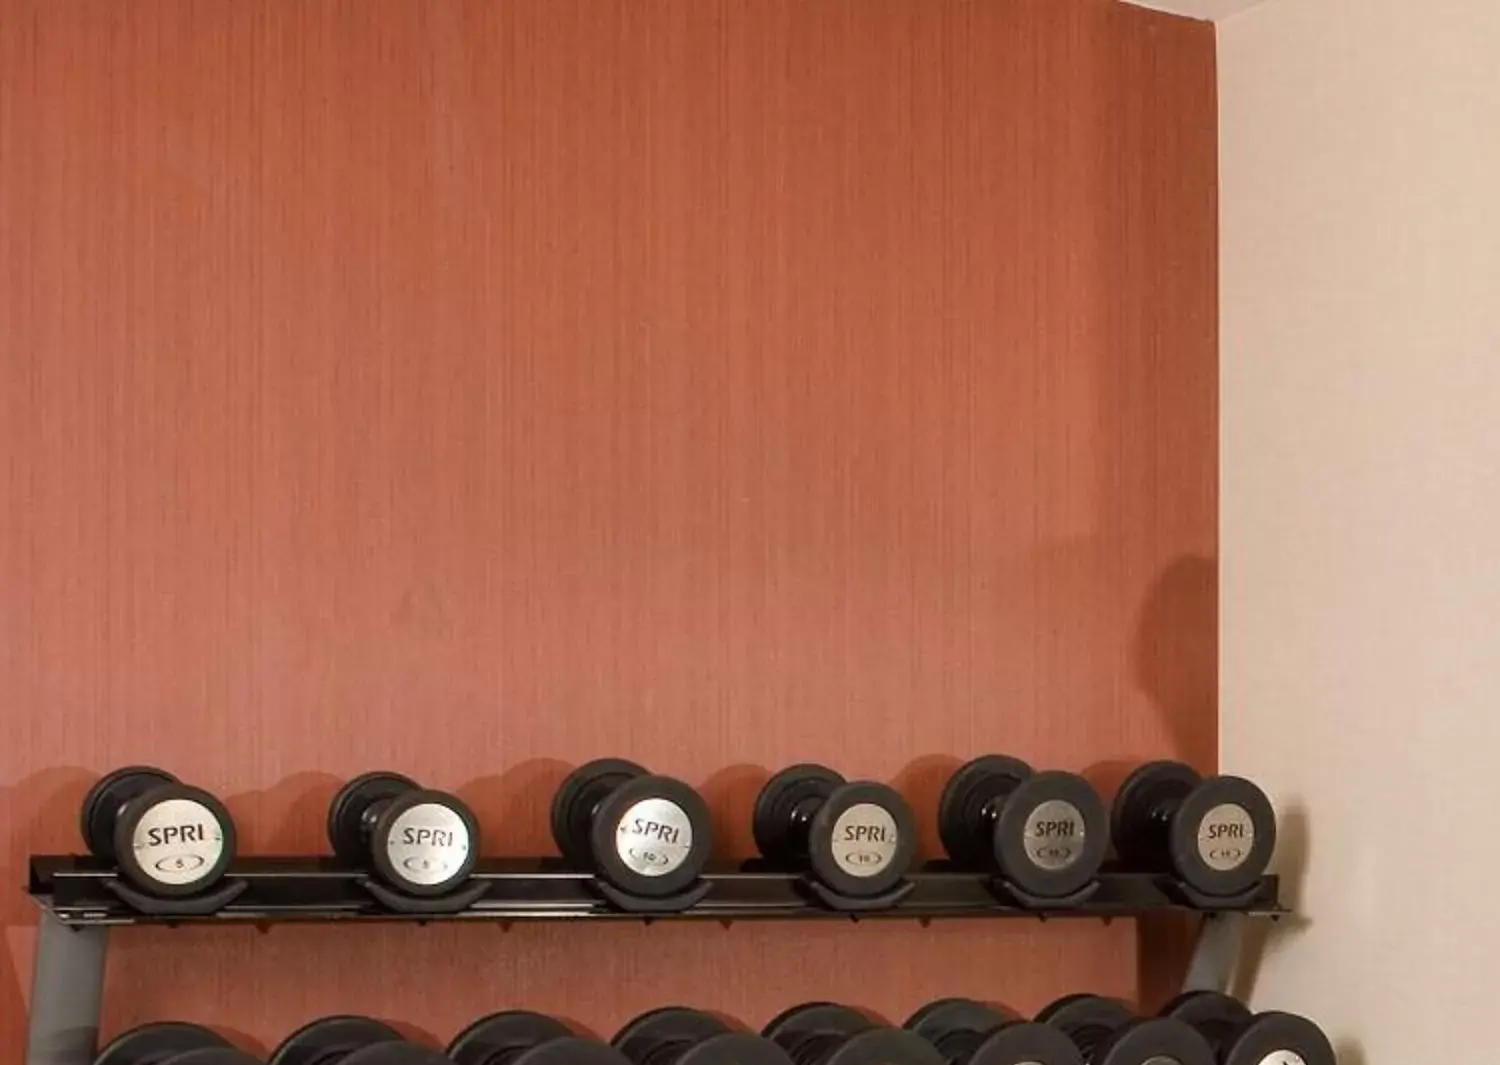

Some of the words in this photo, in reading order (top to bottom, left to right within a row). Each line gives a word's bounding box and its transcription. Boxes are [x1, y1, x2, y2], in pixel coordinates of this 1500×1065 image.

[147, 823, 204, 847] SPRI
[403, 827, 454, 848] SPRI
[632, 818, 679, 844] SPRI
[843, 825, 886, 843] SPRI
[1034, 820, 1075, 837] SPRI
[1207, 822, 1245, 839] SPRI
